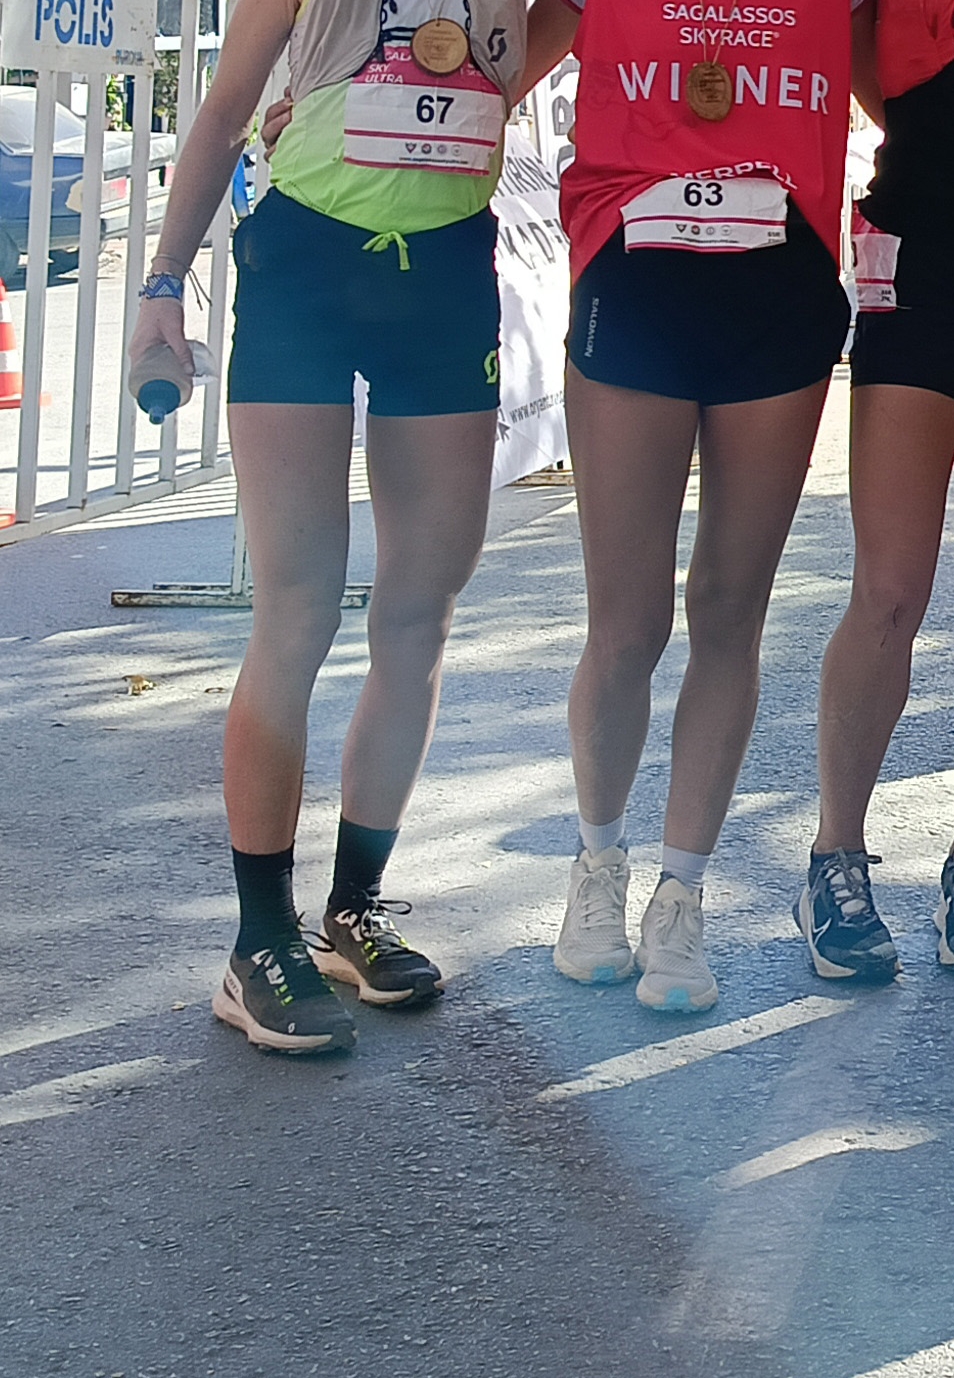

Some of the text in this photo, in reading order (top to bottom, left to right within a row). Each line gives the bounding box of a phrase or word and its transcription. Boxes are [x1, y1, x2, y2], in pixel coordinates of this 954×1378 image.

[663, 3, 796, 26] SAGALASSOS
[365, 73, 404, 84] ULTRA
[368, 63, 390, 74] SKY
[618, 61, 829, 115] WINER
[416, 94, 455, 124] 67
[683, 182, 724, 207] 63
[584, 297, 600, 358] SALOMON
